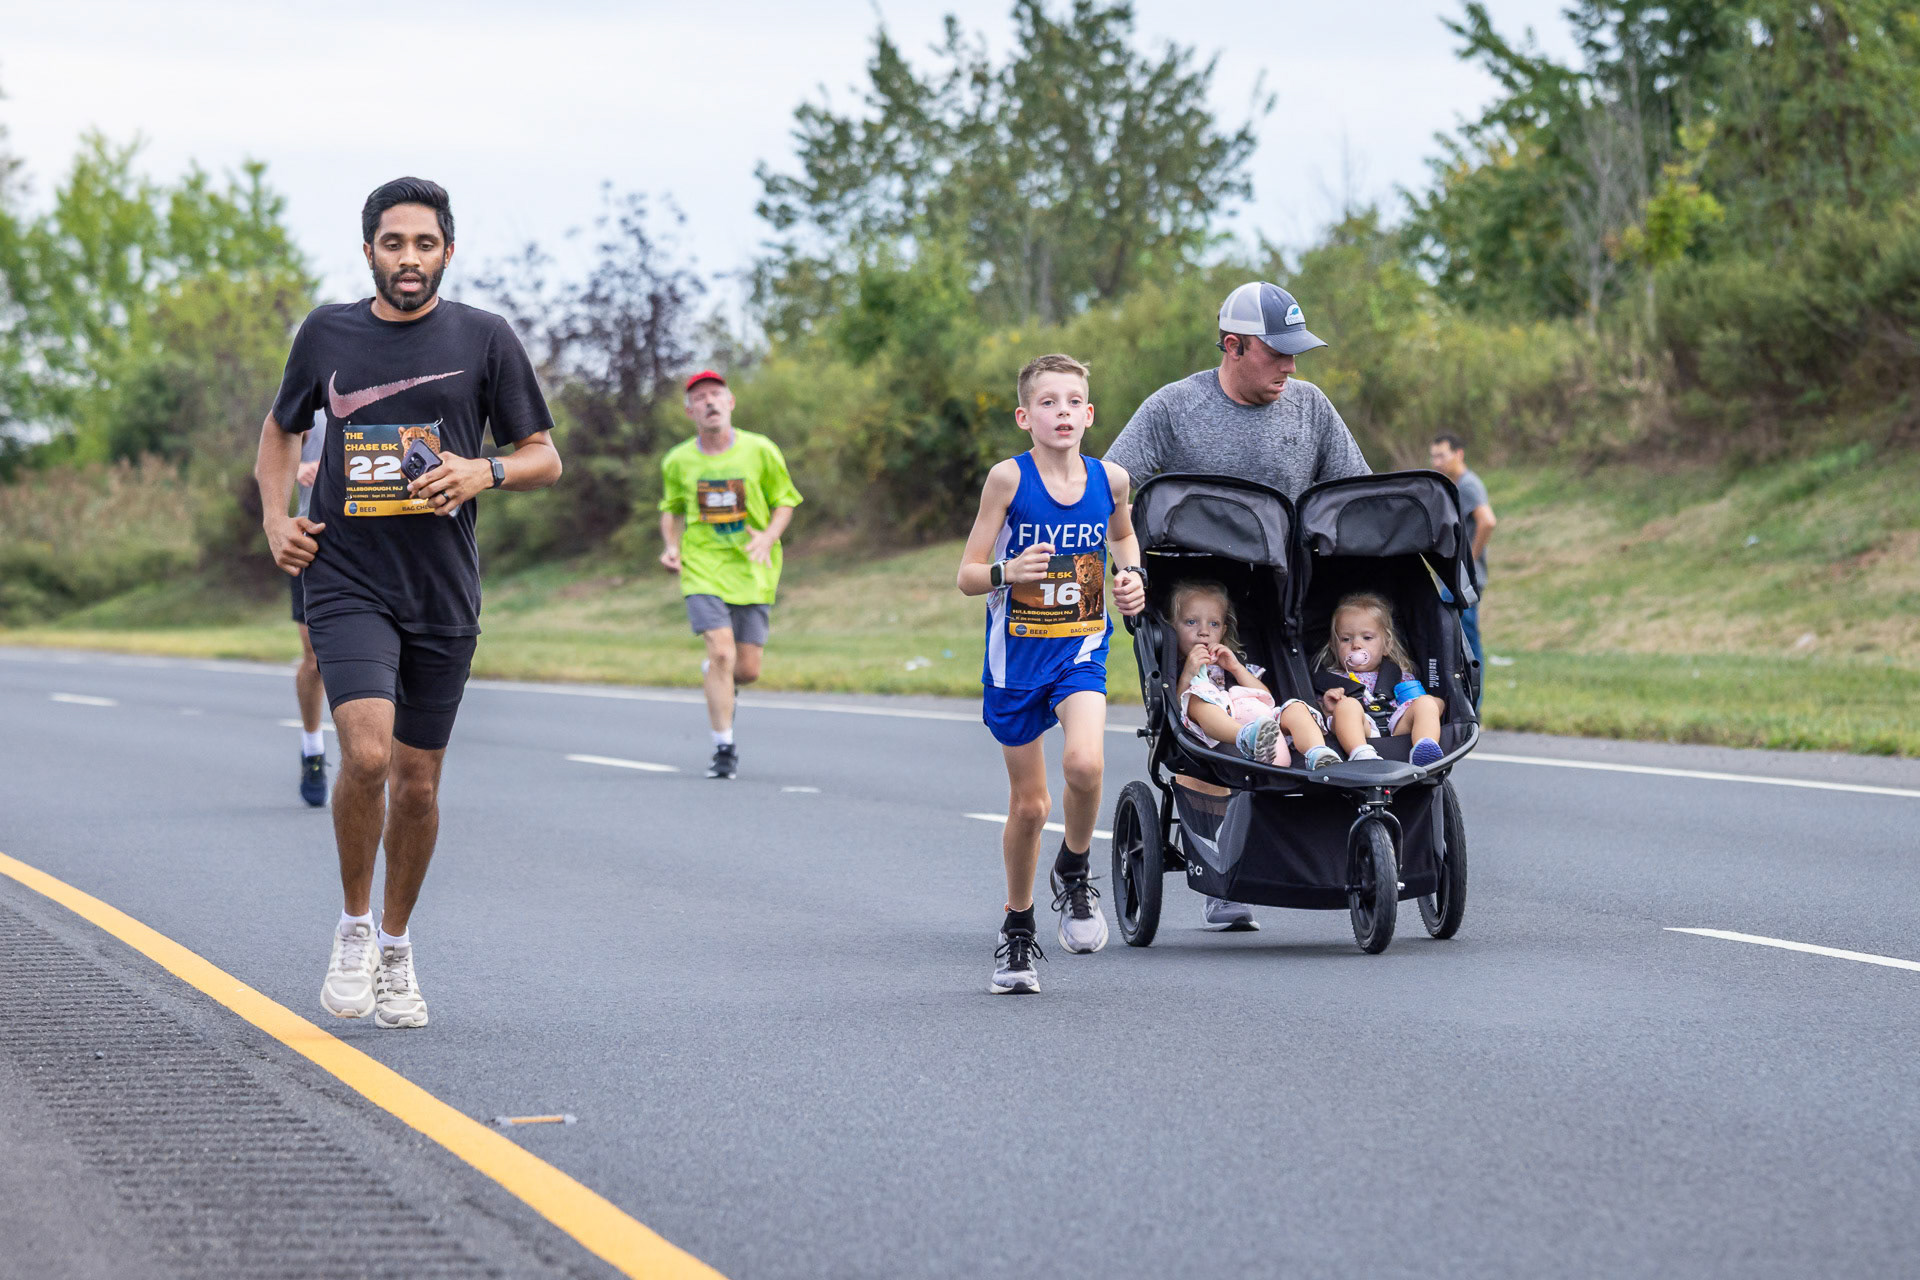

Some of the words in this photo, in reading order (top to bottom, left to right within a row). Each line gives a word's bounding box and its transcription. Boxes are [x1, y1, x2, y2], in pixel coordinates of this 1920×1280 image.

[345, 432, 363, 440] THE
[381, 443, 398, 451] 5K
[349, 455, 402, 481] 22
[1018, 522, 1105, 548] FLYERS
[1058, 571, 1073, 579] 5K
[1039, 582, 1082, 606] 16
